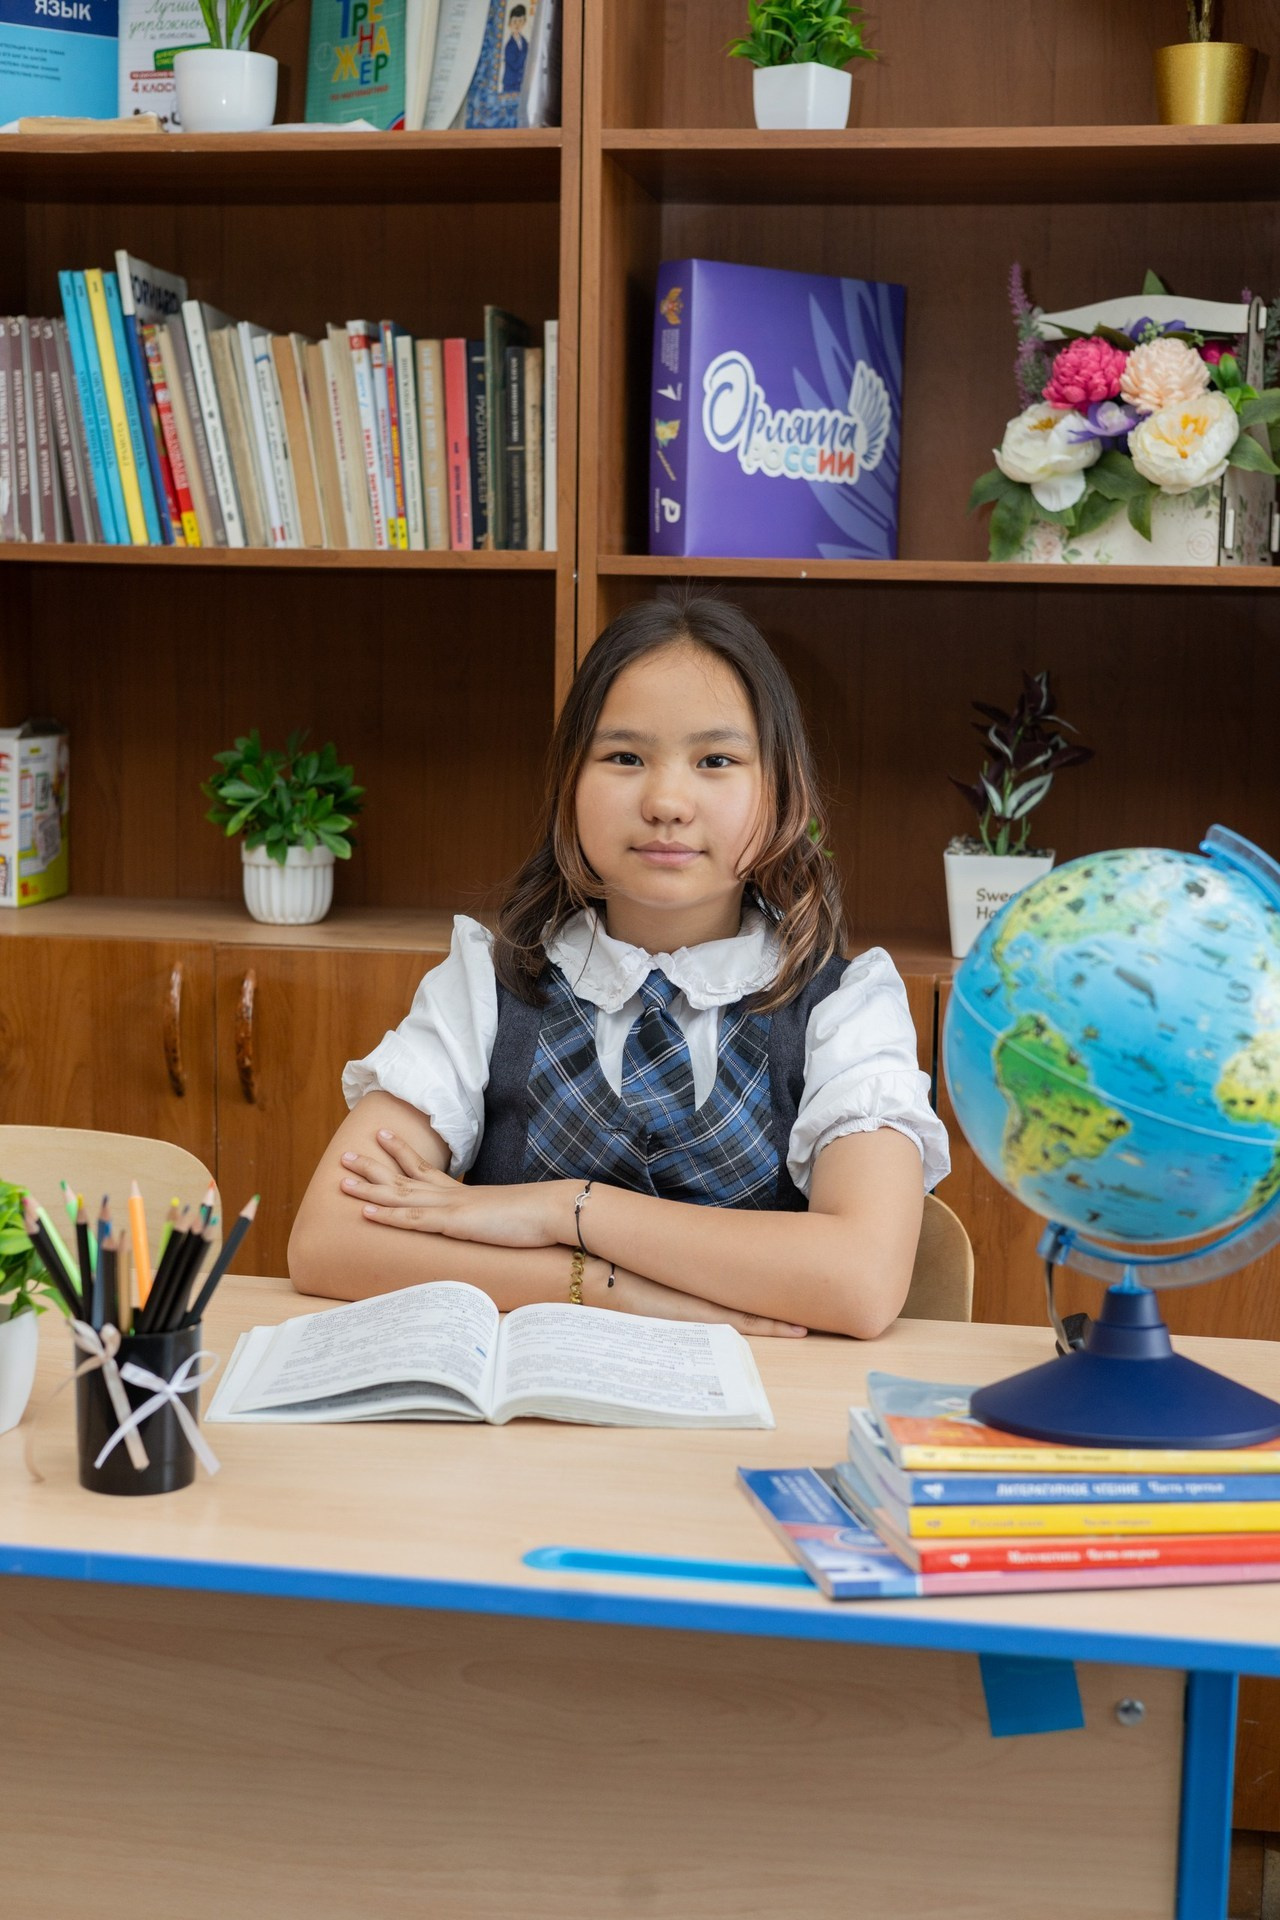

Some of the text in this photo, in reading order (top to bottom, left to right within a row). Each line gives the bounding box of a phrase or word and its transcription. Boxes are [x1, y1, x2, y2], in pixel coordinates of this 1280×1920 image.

[34, 0, 92, 21] ЯЗЫК
[132, 82, 139, 93] 4
[709, 358, 857, 456] Орлята
[745, 446, 855, 478] РОССИИ
[996, 1482, 1088, 1497] ЛИТЕРАТУРНОЕ
[1092, 1481, 1141, 1496] ЧТЕНИЕ
[1147, 1481, 1184, 1494] Часть
[1007, 1550, 1081, 1564] Математика
